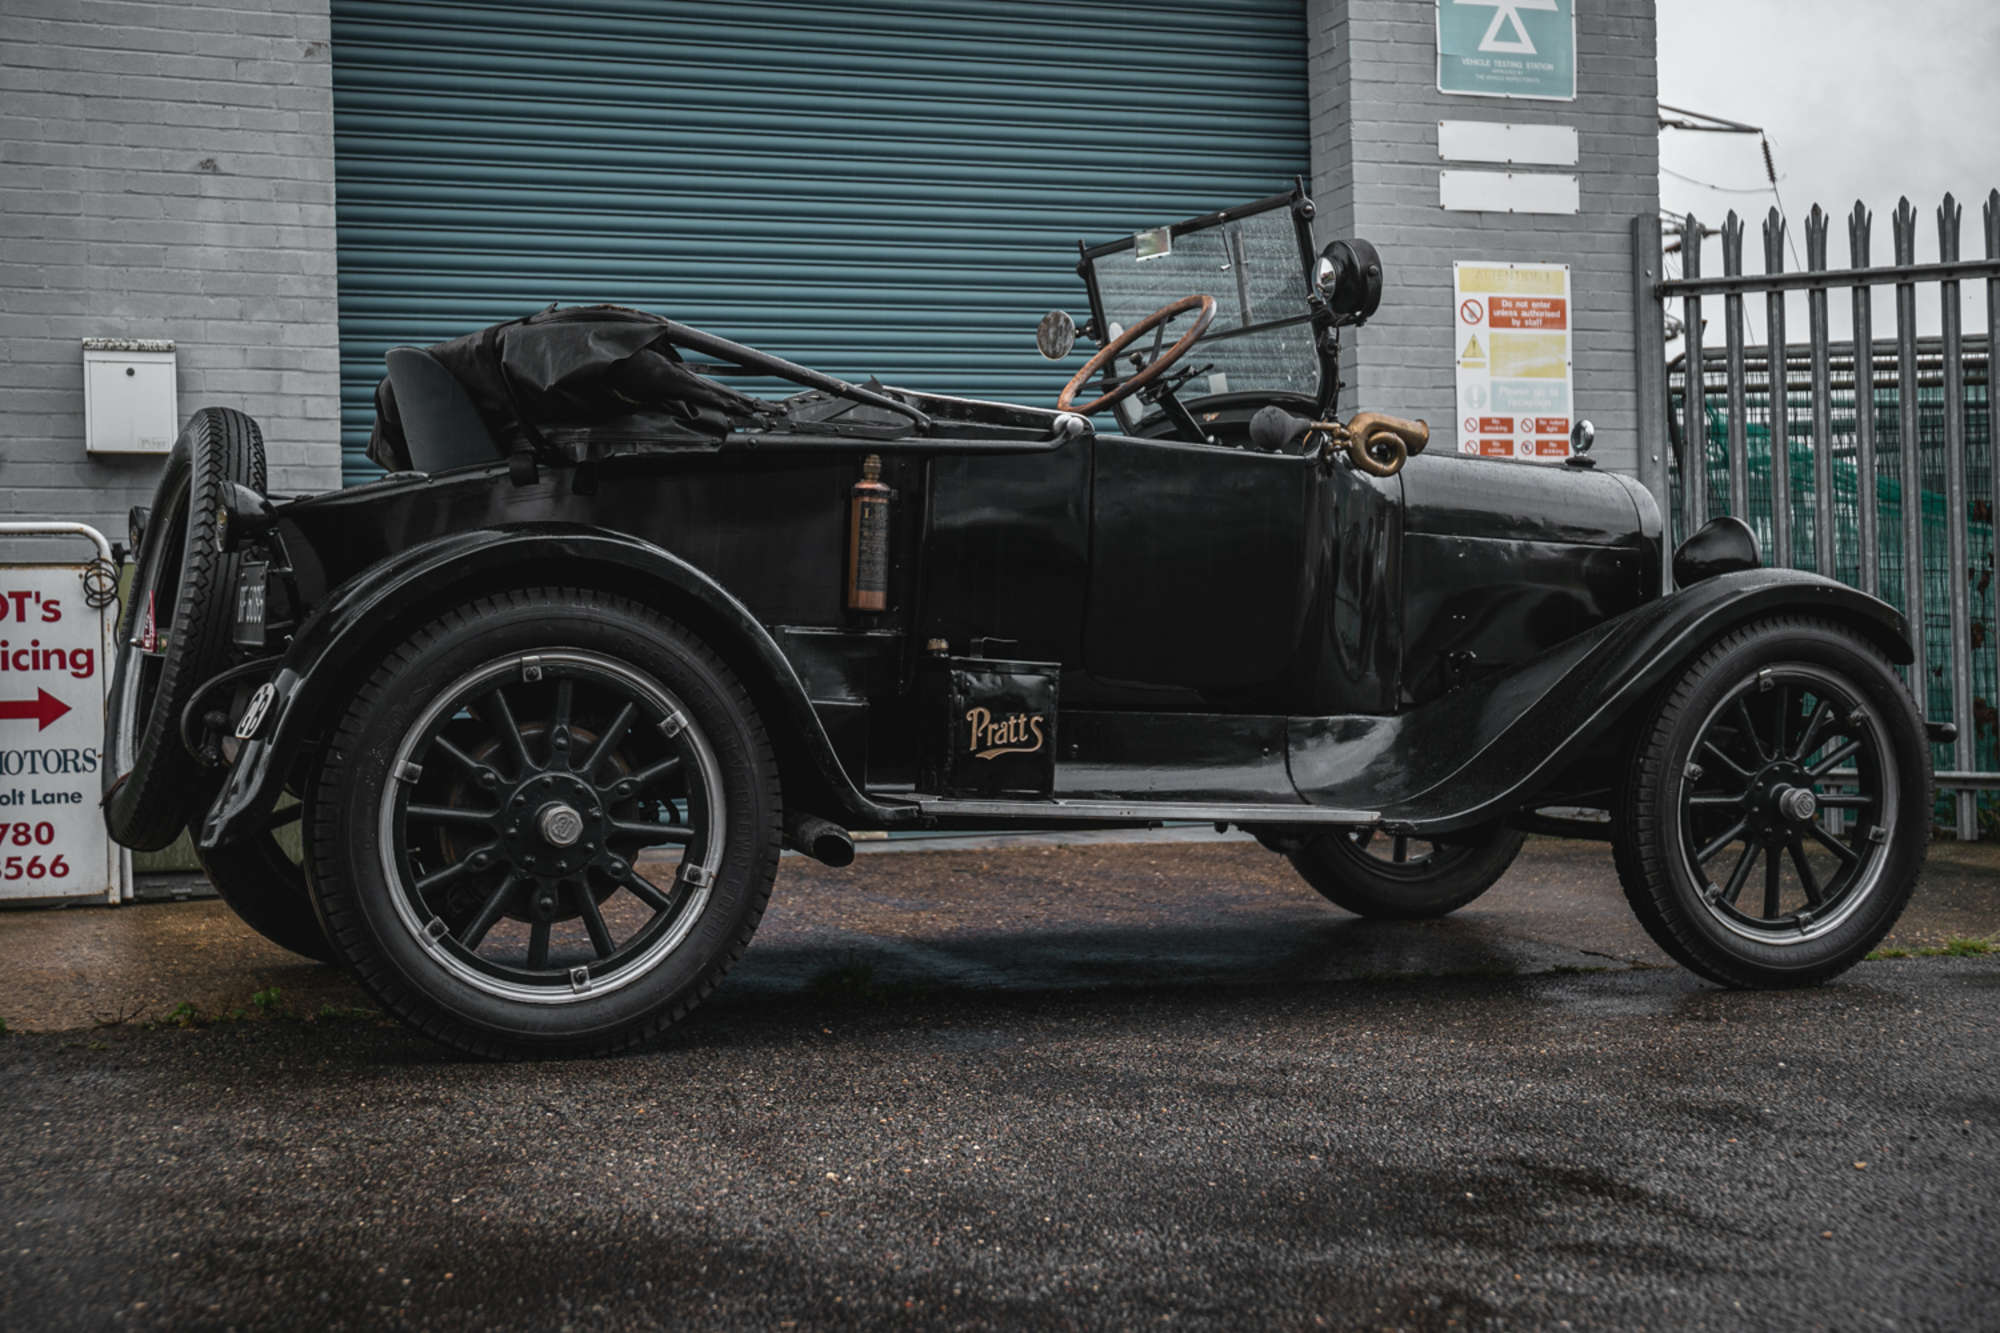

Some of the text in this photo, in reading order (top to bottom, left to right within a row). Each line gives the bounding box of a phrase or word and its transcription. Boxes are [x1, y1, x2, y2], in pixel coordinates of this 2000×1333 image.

[1462, 58, 1554, 71] VEHICLE TESTING STATION
[1502, 299, 1551, 309] Do not enter
[1493, 309, 1518, 317] unless
[1511, 318, 1543, 327] by staff
[966, 707, 1044, 760] Pratts
[32, 788, 83, 805] Lane
[0, 854, 70, 880] 566
